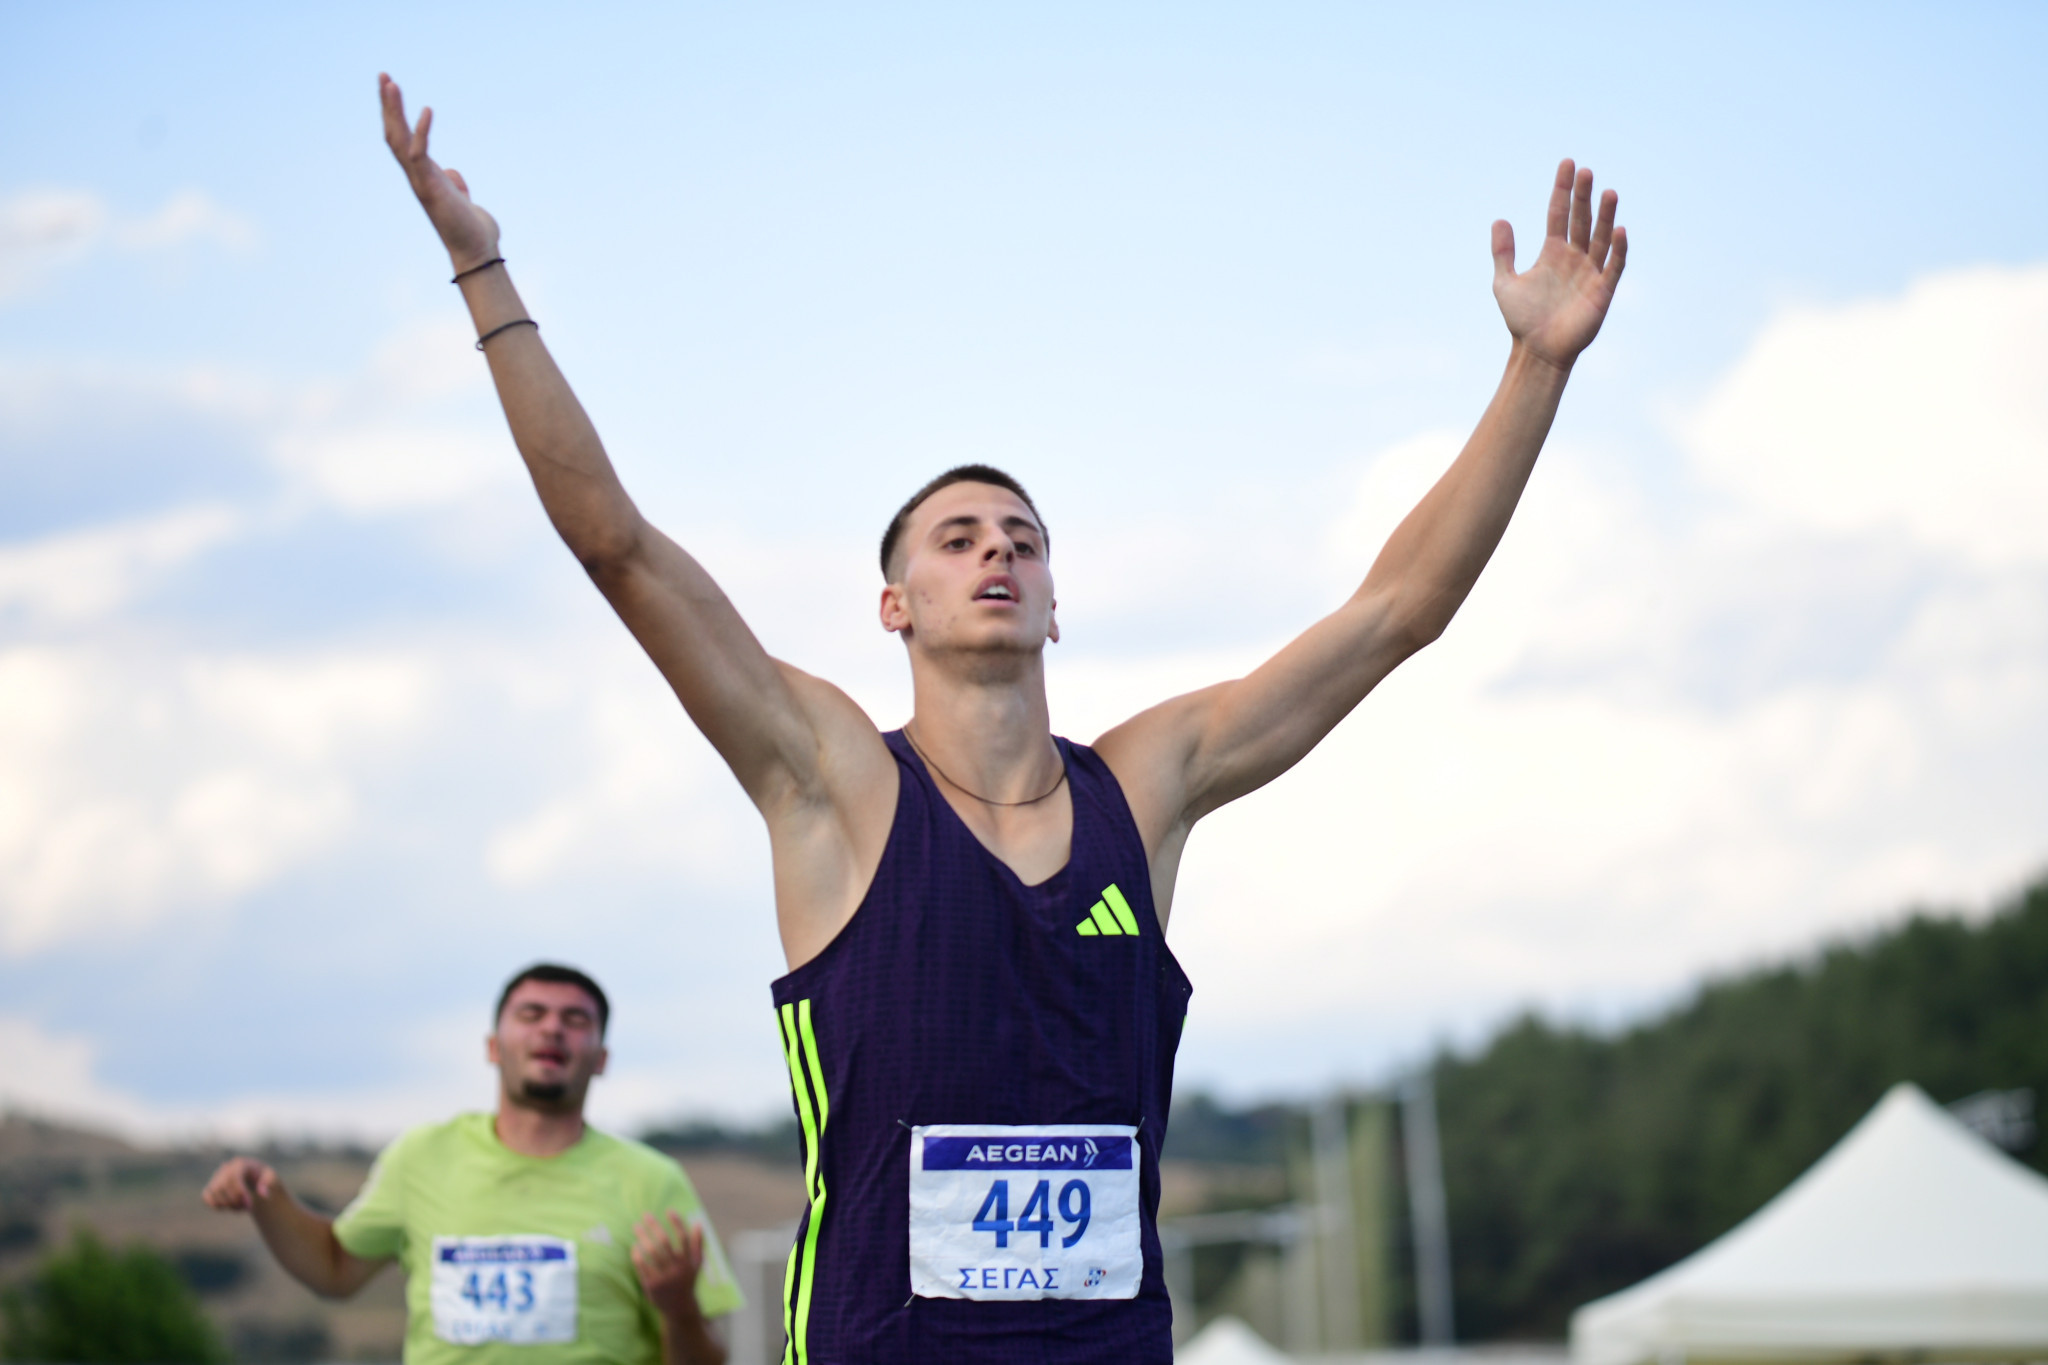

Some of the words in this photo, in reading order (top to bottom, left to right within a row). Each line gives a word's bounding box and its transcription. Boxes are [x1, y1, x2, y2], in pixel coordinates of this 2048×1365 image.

[966, 1145, 1077, 1162] AEGEAN
[972, 1179, 1091, 1248] 449
[461, 1270, 534, 1312] 443
[958, 1268, 1059, 1289] ΣΕΓΑΣ
